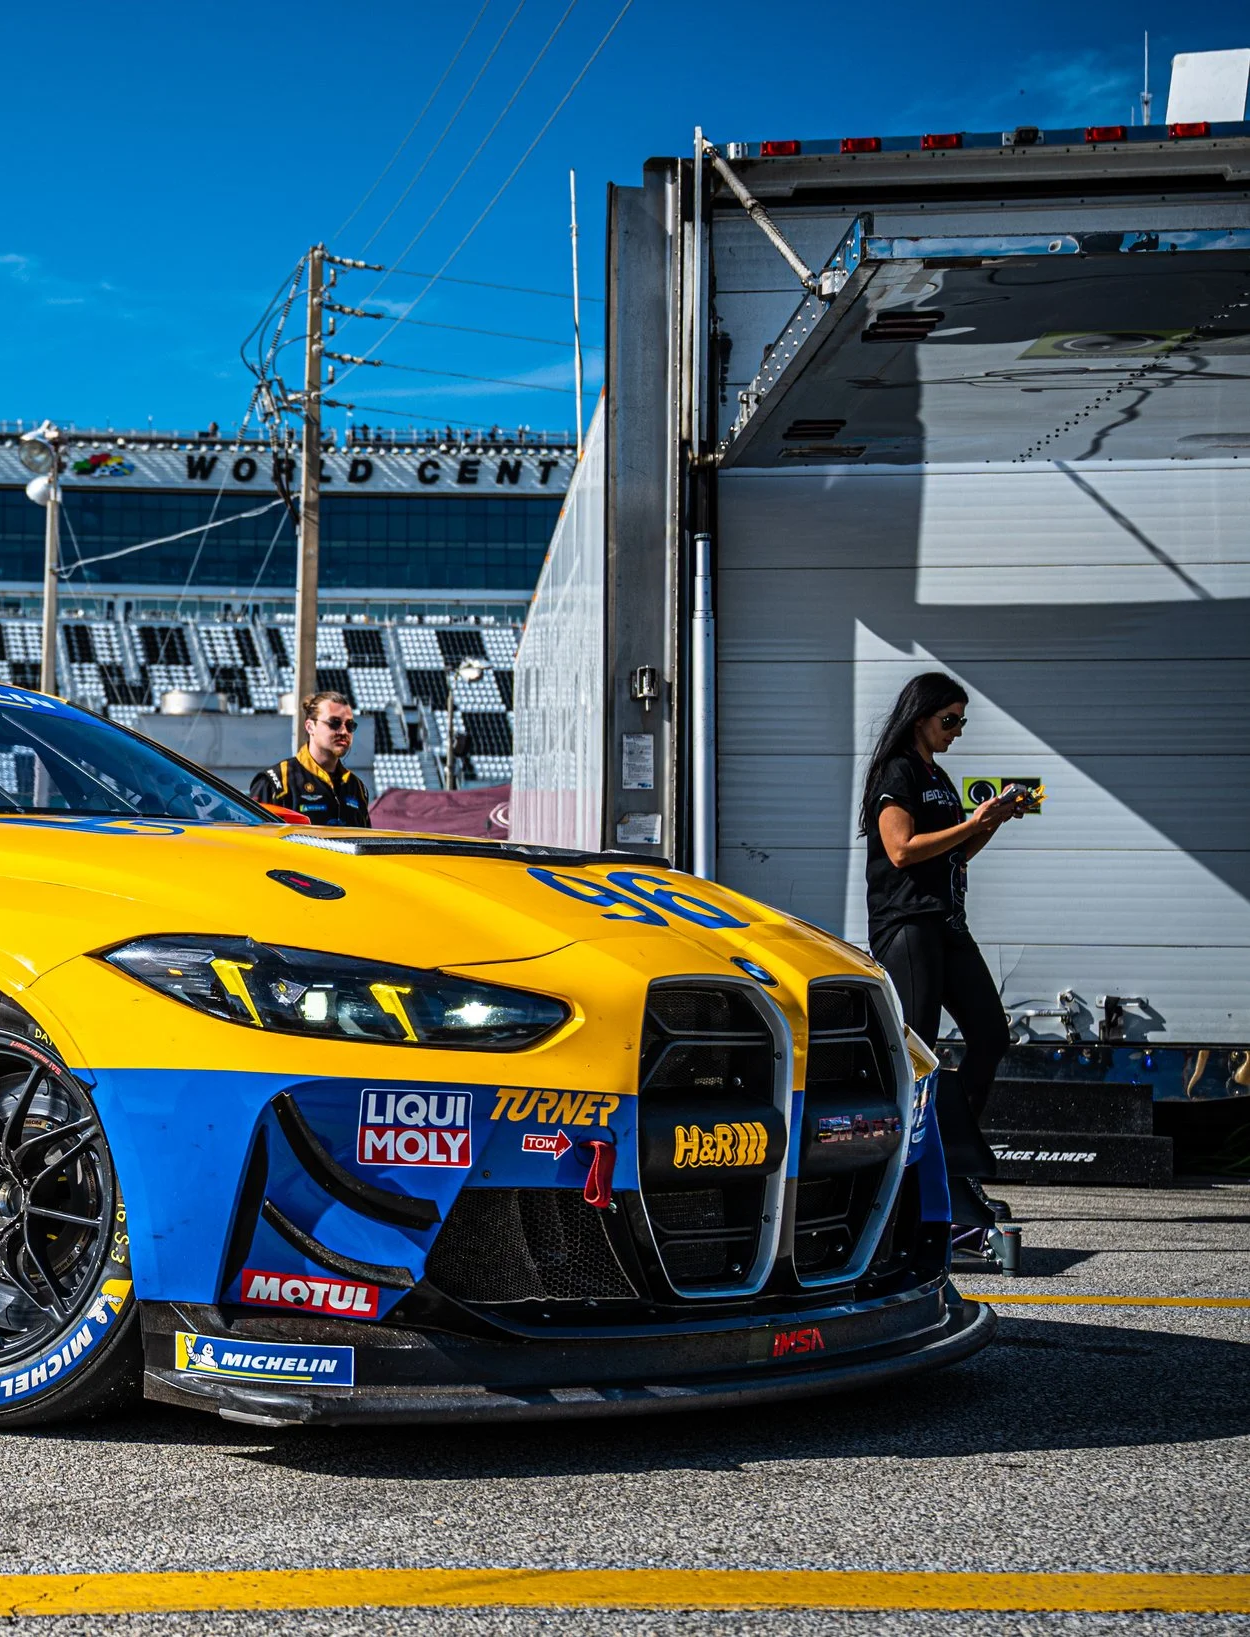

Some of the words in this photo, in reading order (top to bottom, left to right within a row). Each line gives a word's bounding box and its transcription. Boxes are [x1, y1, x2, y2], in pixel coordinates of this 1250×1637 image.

[527, 867, 751, 929] 96
[366, 1093, 466, 1127] LIQUI
[490, 1088, 620, 1127] TURNER
[364, 1130, 469, 1163] MOLY
[527, 1137, 558, 1150] TOW
[673, 1124, 740, 1168] H&R
[1035, 1151, 1097, 1162] RAMPS
[247, 1275, 372, 1312] MOTUL
[772, 1327, 826, 1357] IMSA
[221, 1352, 338, 1373] MICHELIN
